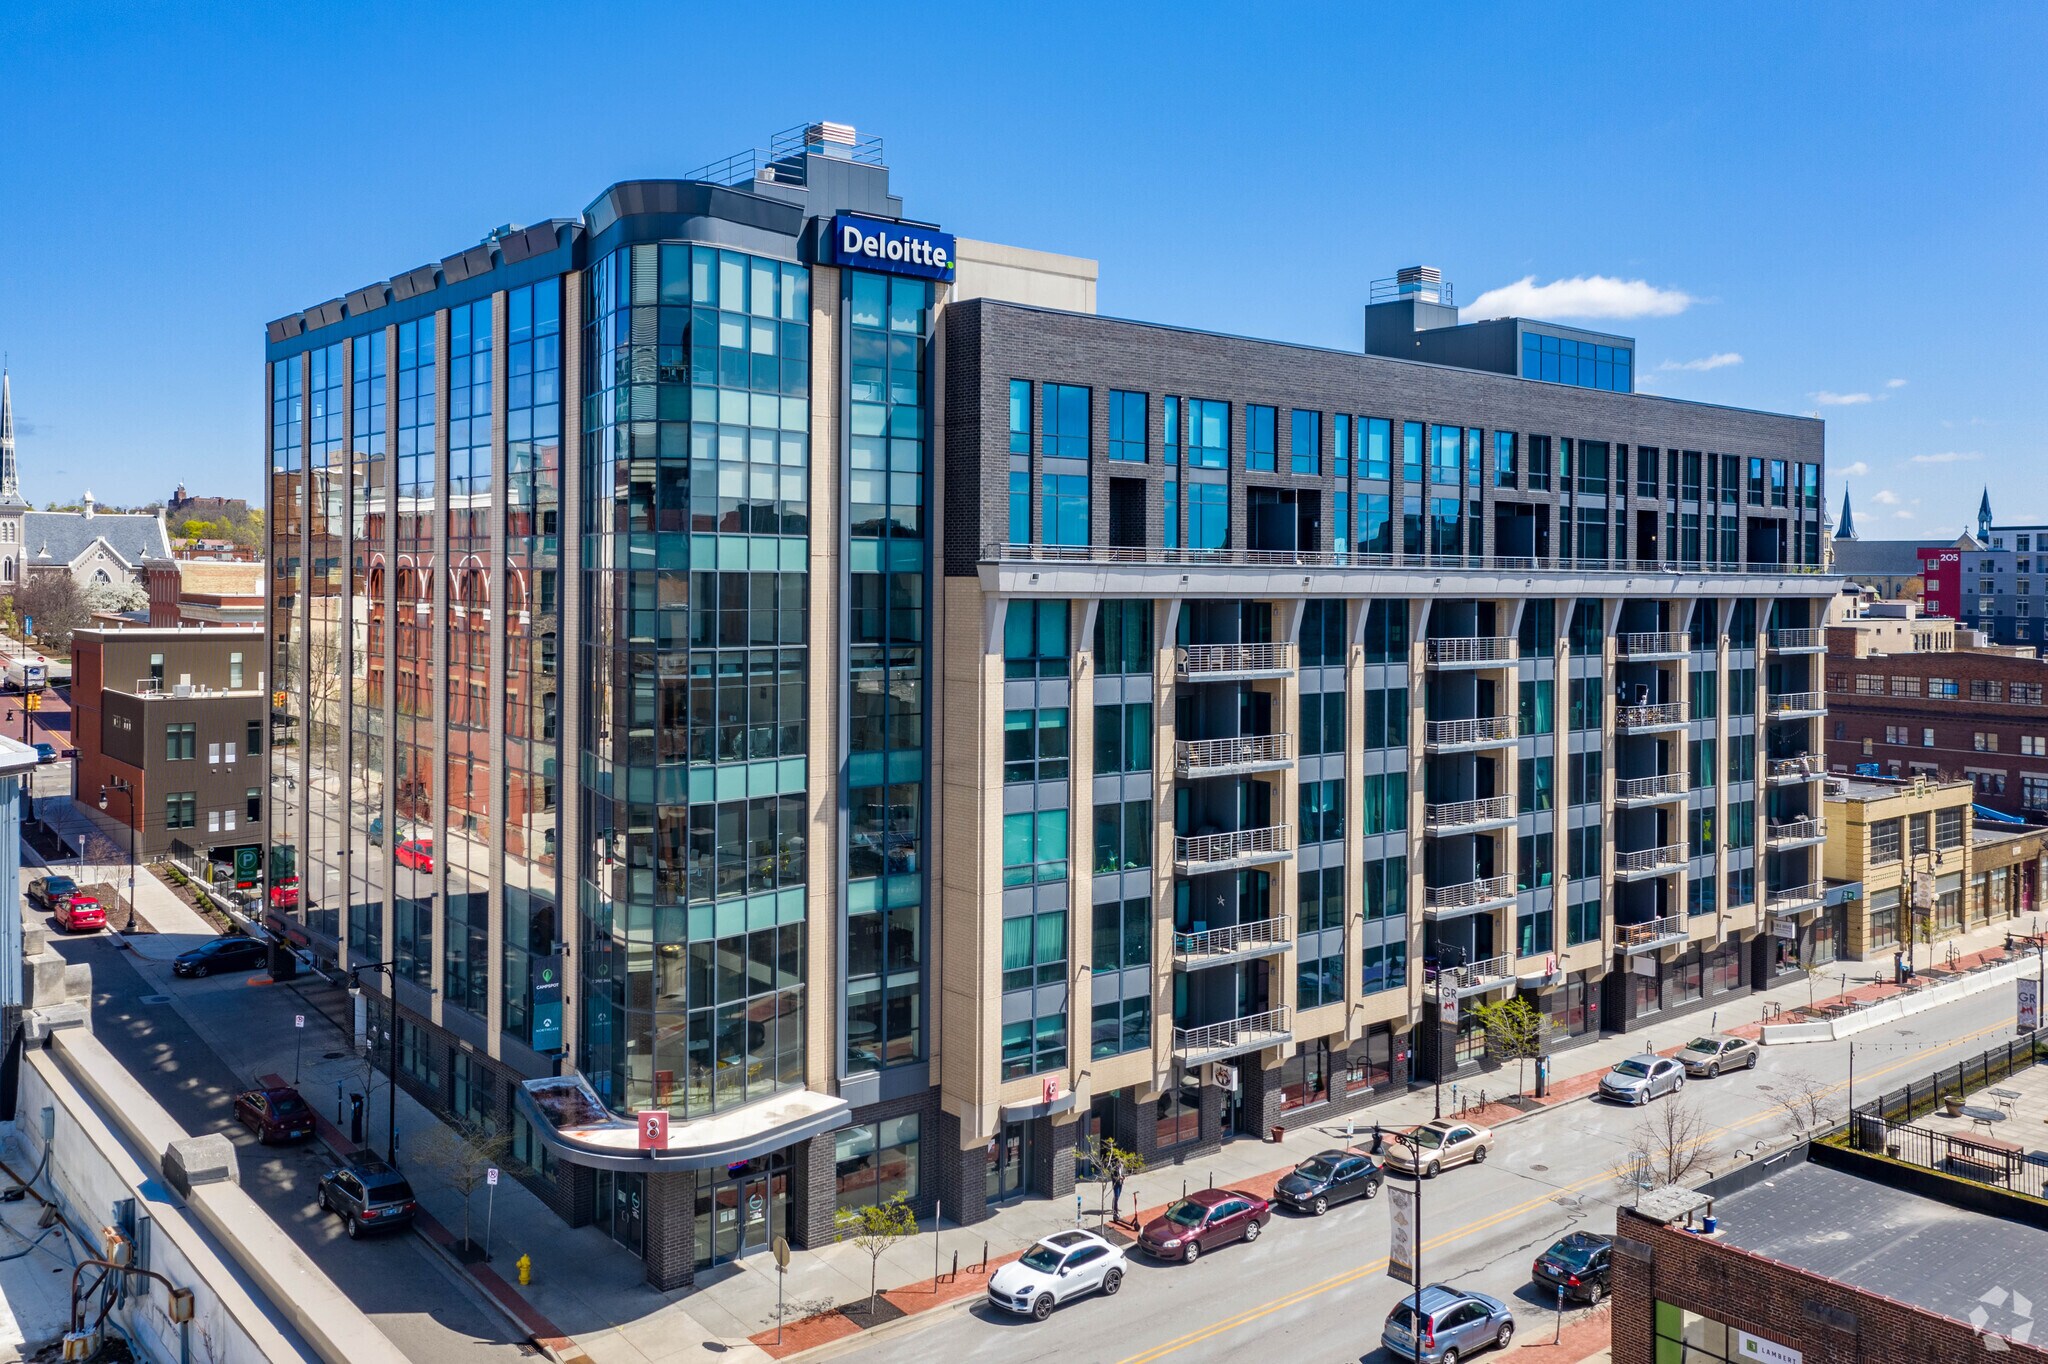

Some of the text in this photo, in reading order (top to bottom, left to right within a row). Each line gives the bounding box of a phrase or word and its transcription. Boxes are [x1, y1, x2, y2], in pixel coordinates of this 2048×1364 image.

[1939, 553, 1959, 562] 205
[243, 853, 253, 867] P
[536, 982, 559, 990] CAMPSPOT
[1442, 987, 1457, 999] GR
[2018, 992, 2036, 1003] GR
[1049, 1081, 1057, 1095] 8
[646, 1117, 660, 1140] 8
[1761, 1347, 1797, 1364] LAMBERT
